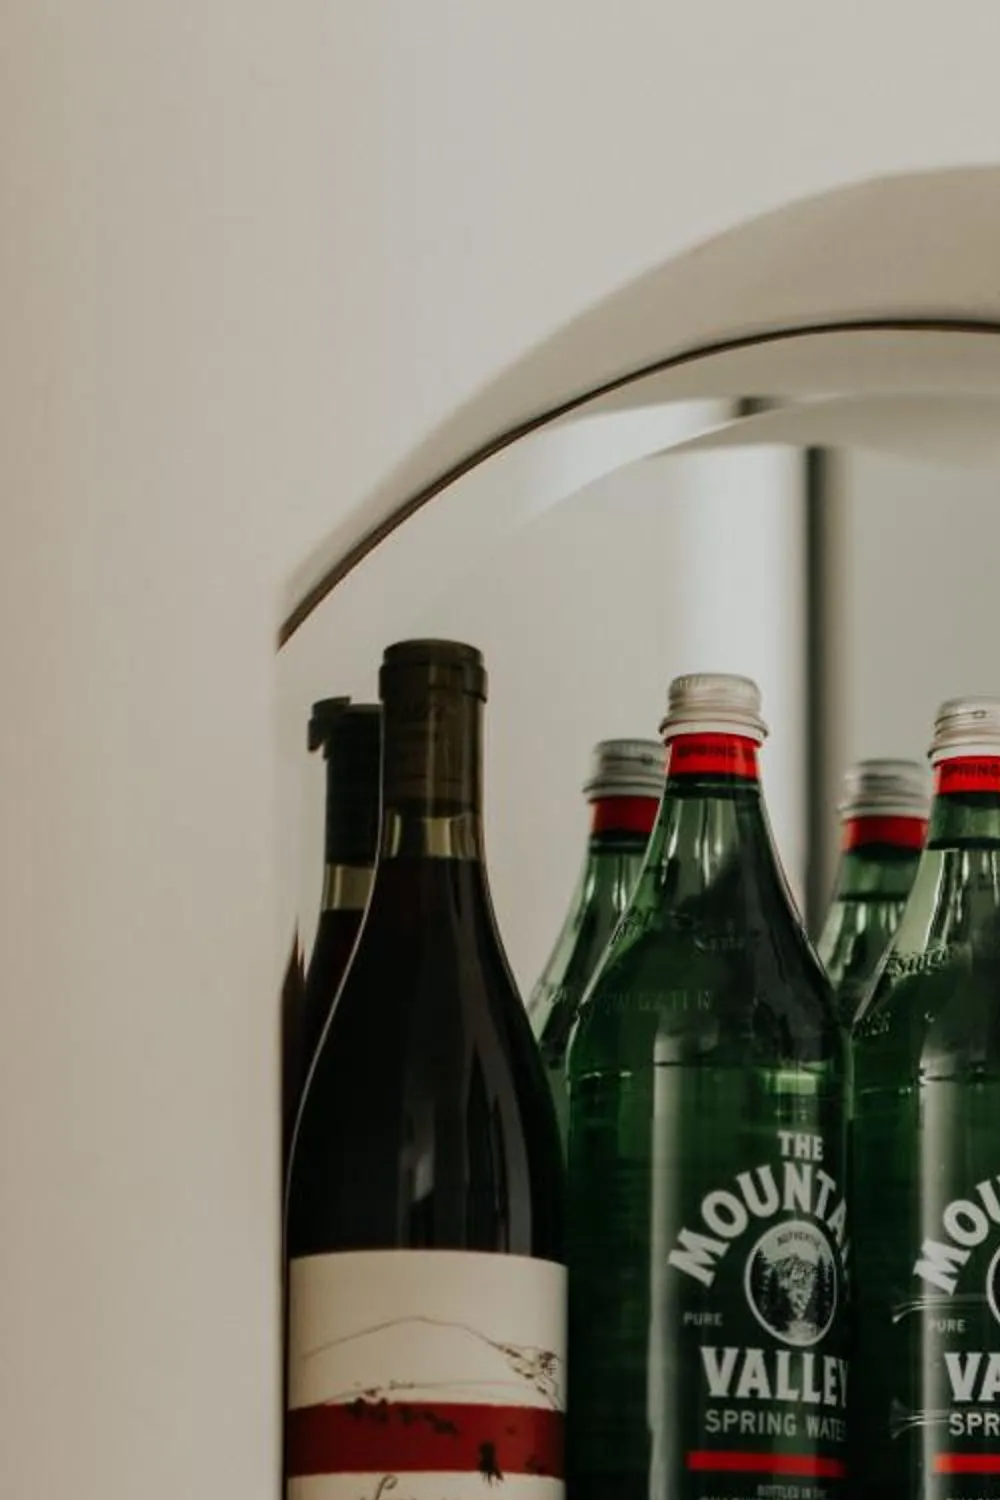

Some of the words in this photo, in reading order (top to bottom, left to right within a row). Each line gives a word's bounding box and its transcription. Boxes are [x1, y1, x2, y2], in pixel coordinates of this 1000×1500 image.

[778, 1130, 824, 1163] THE
[684, 1311, 722, 1327] PURE
[930, 1319, 965, 1333] PURE
[701, 1345, 848, 1408] VALLEY
[704, 1410, 797, 1436] SPRING
